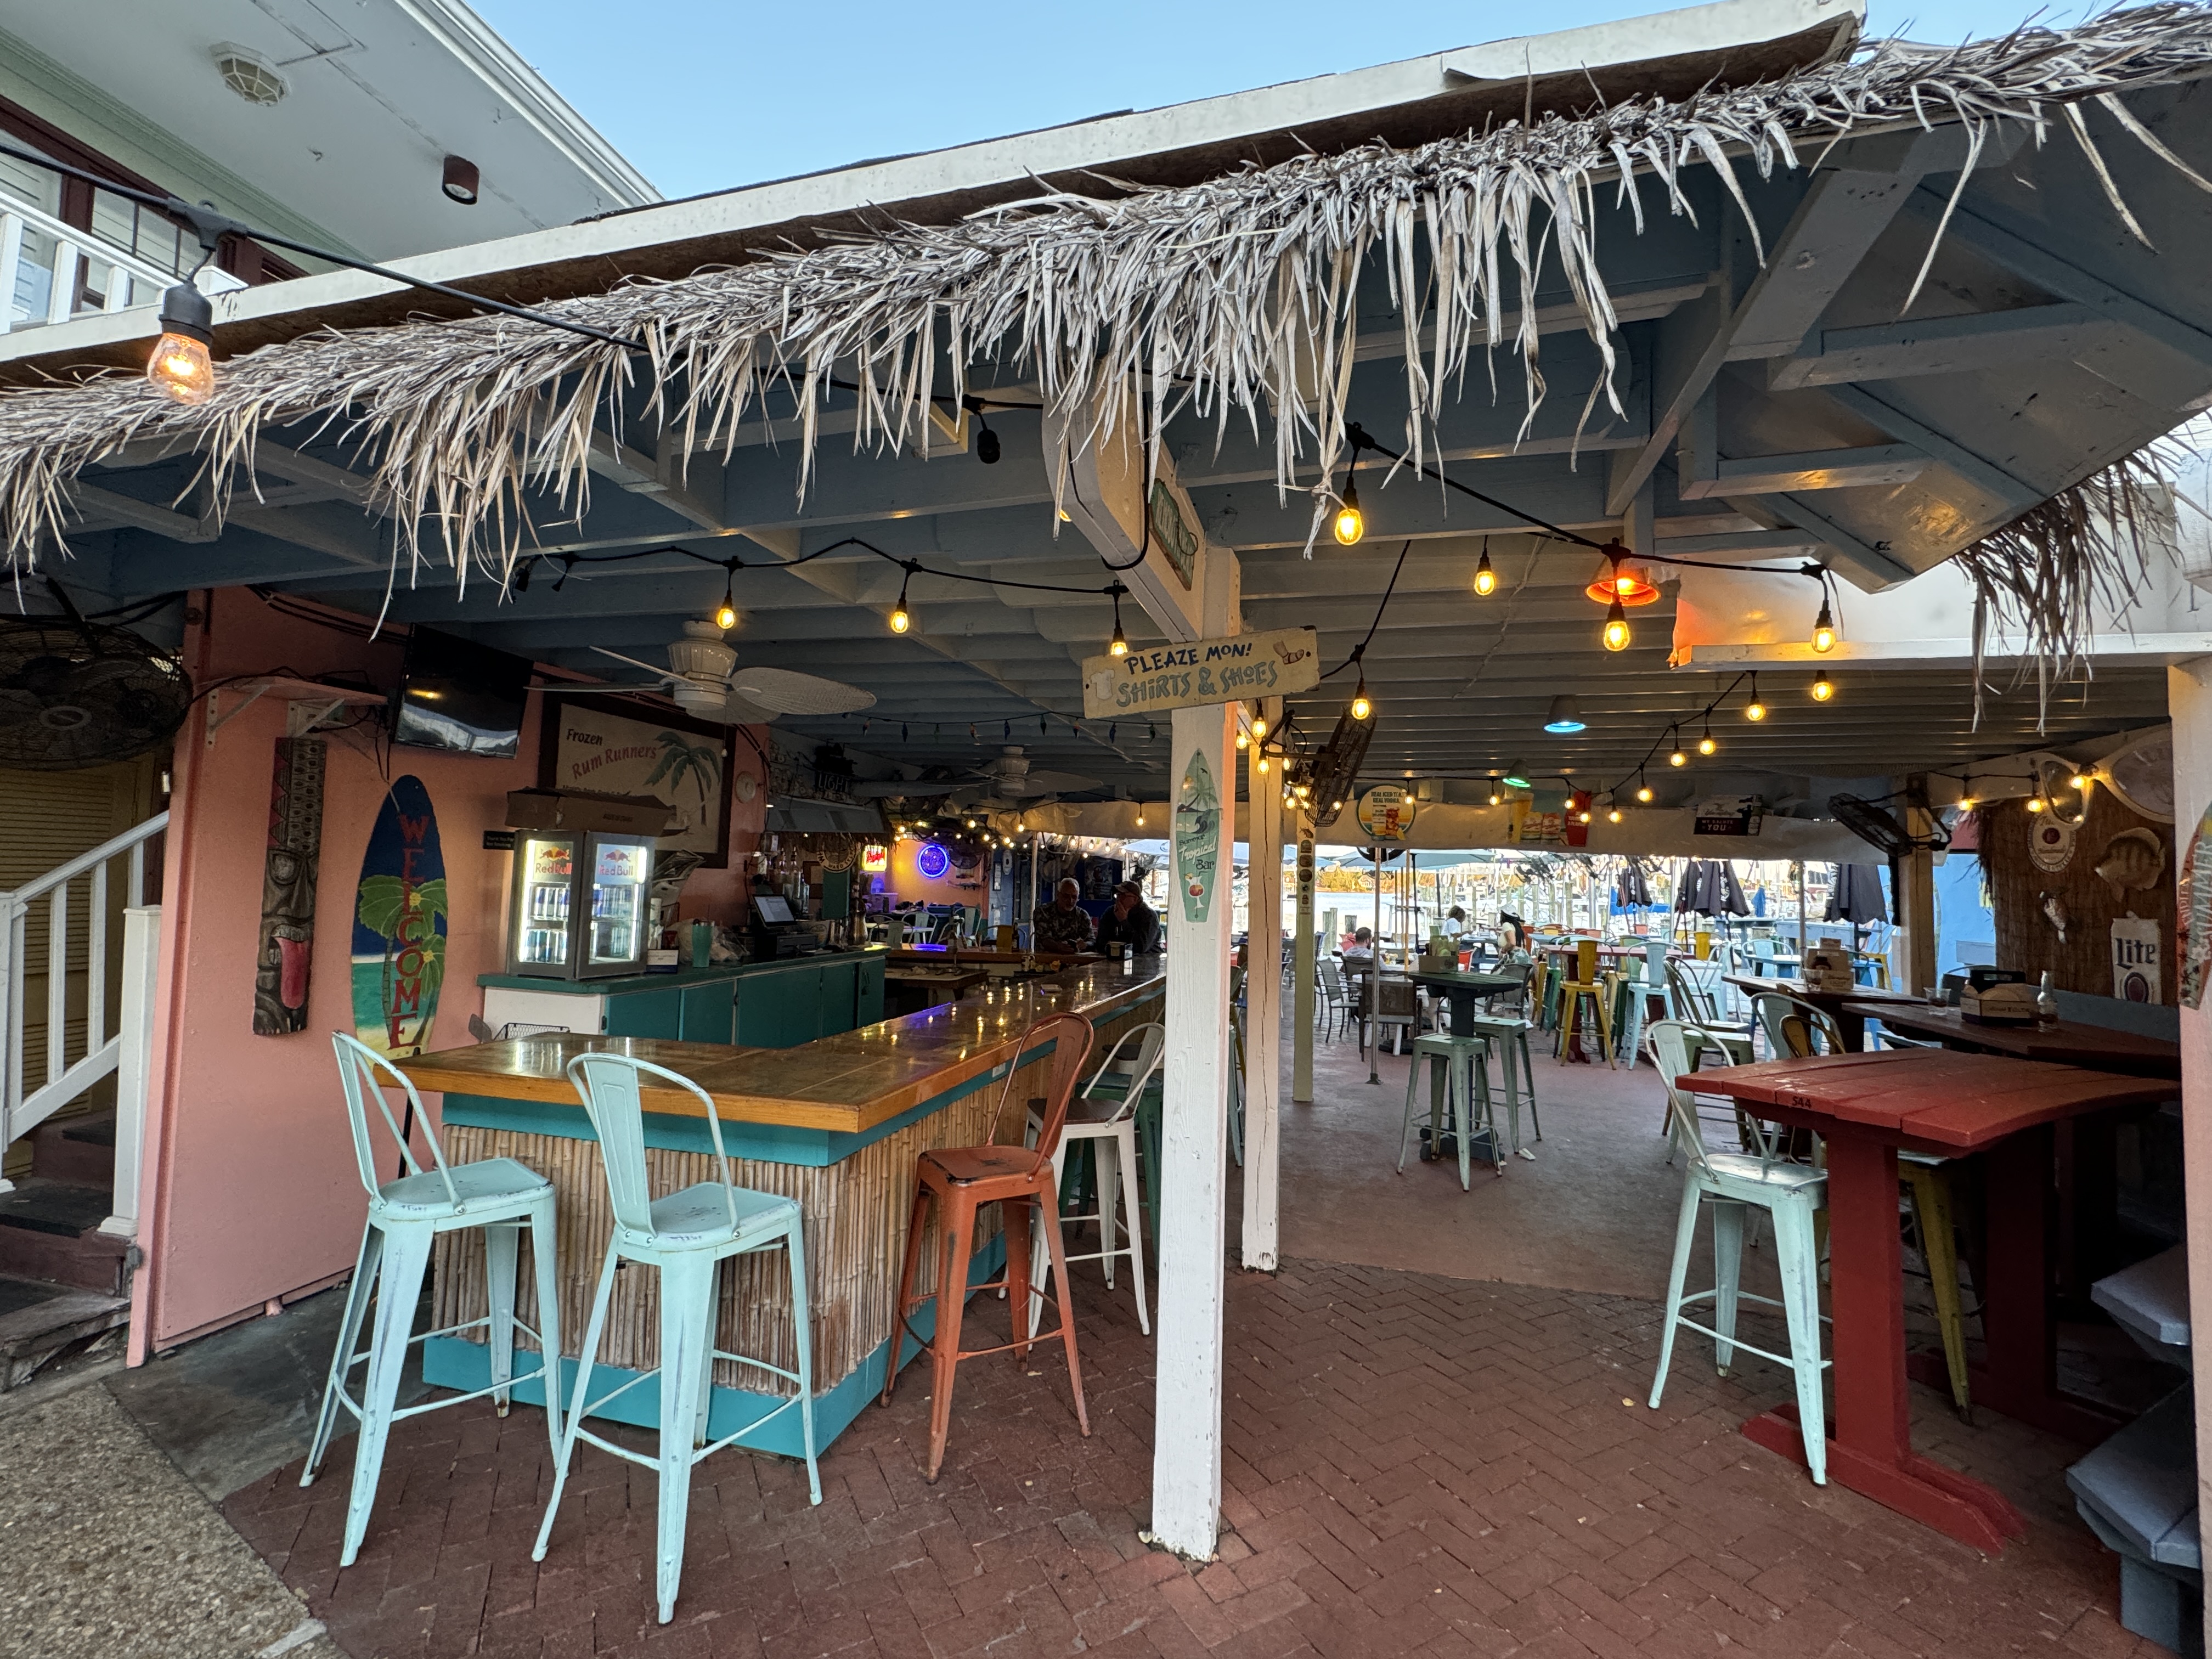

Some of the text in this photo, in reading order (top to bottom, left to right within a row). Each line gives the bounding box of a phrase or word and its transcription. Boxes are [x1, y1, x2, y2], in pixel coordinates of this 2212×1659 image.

[1124, 642, 1252, 675] PLEAZE MON!
[1198, 667, 1217, 696] &
[1220, 660, 1278, 694] SHOES
[566, 729, 603, 746] Frozen
[572, 746, 657, 780] Rum Runners
[818, 772, 850, 793] LIGHT
[1178, 835, 1217, 865] Tropical
[535, 862, 572, 874] Red Bull
[598, 864, 633, 876] Red Bull
[1195, 859, 1215, 870] Bar
[387, 814, 430, 1050] WELCOME
[2114, 937, 2157, 970] Lite
[1792, 1096, 1812, 1109] 544
